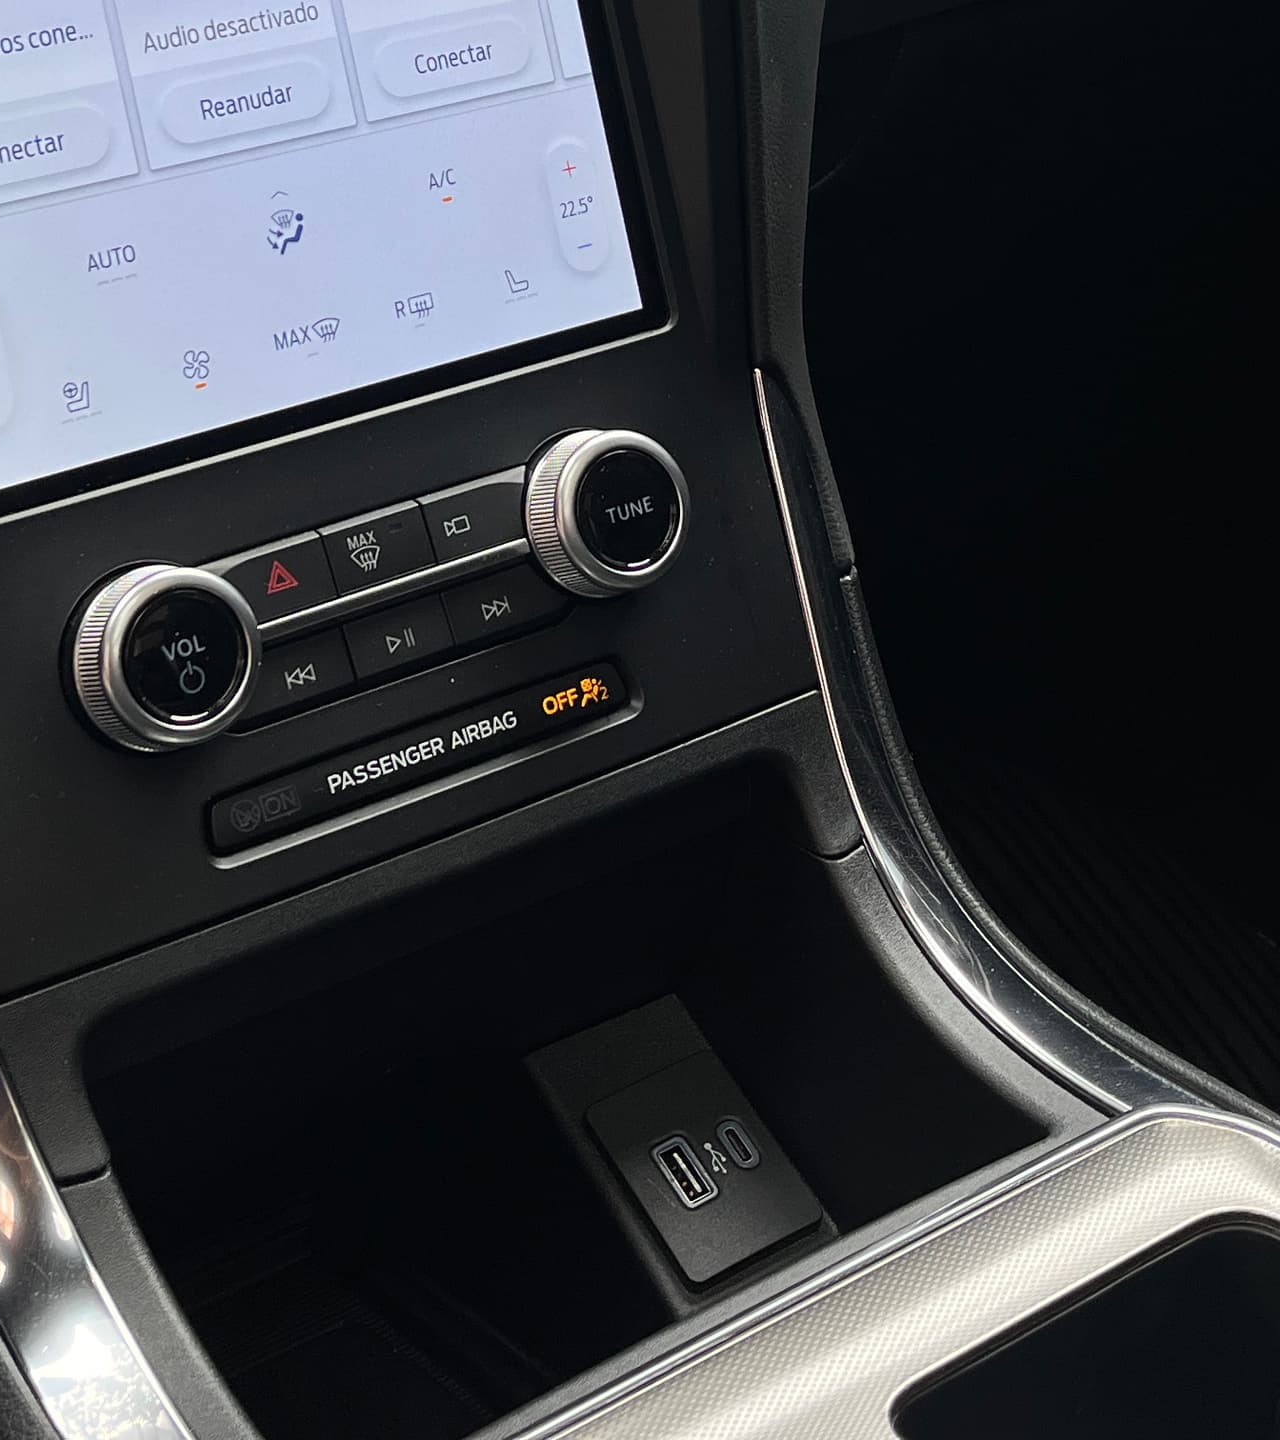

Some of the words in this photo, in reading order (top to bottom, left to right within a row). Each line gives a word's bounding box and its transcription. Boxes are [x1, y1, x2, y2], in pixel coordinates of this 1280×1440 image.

[28, 25, 94, 49] cone...
[144, 25, 200, 54] Audio
[203, 1, 319, 41] desactivado
[414, 44, 492, 74] Conectar
[199, 85, 292, 121] Reanudar
[429, 168, 457, 191] A/C
[559, 195, 594, 219] 22.5°
[87, 244, 136, 273] AUTO
[394, 300, 406, 319] R
[273, 325, 312, 351] MAX
[605, 495, 654, 524] TUNE
[346, 530, 377, 551] MAX
[161, 637, 206, 662] VOL
[264, 789, 298, 815] ON
[327, 737, 445, 794] PASSENGER
[451, 710, 517, 750] AIRBAG
[542, 687, 579, 715] OFF
